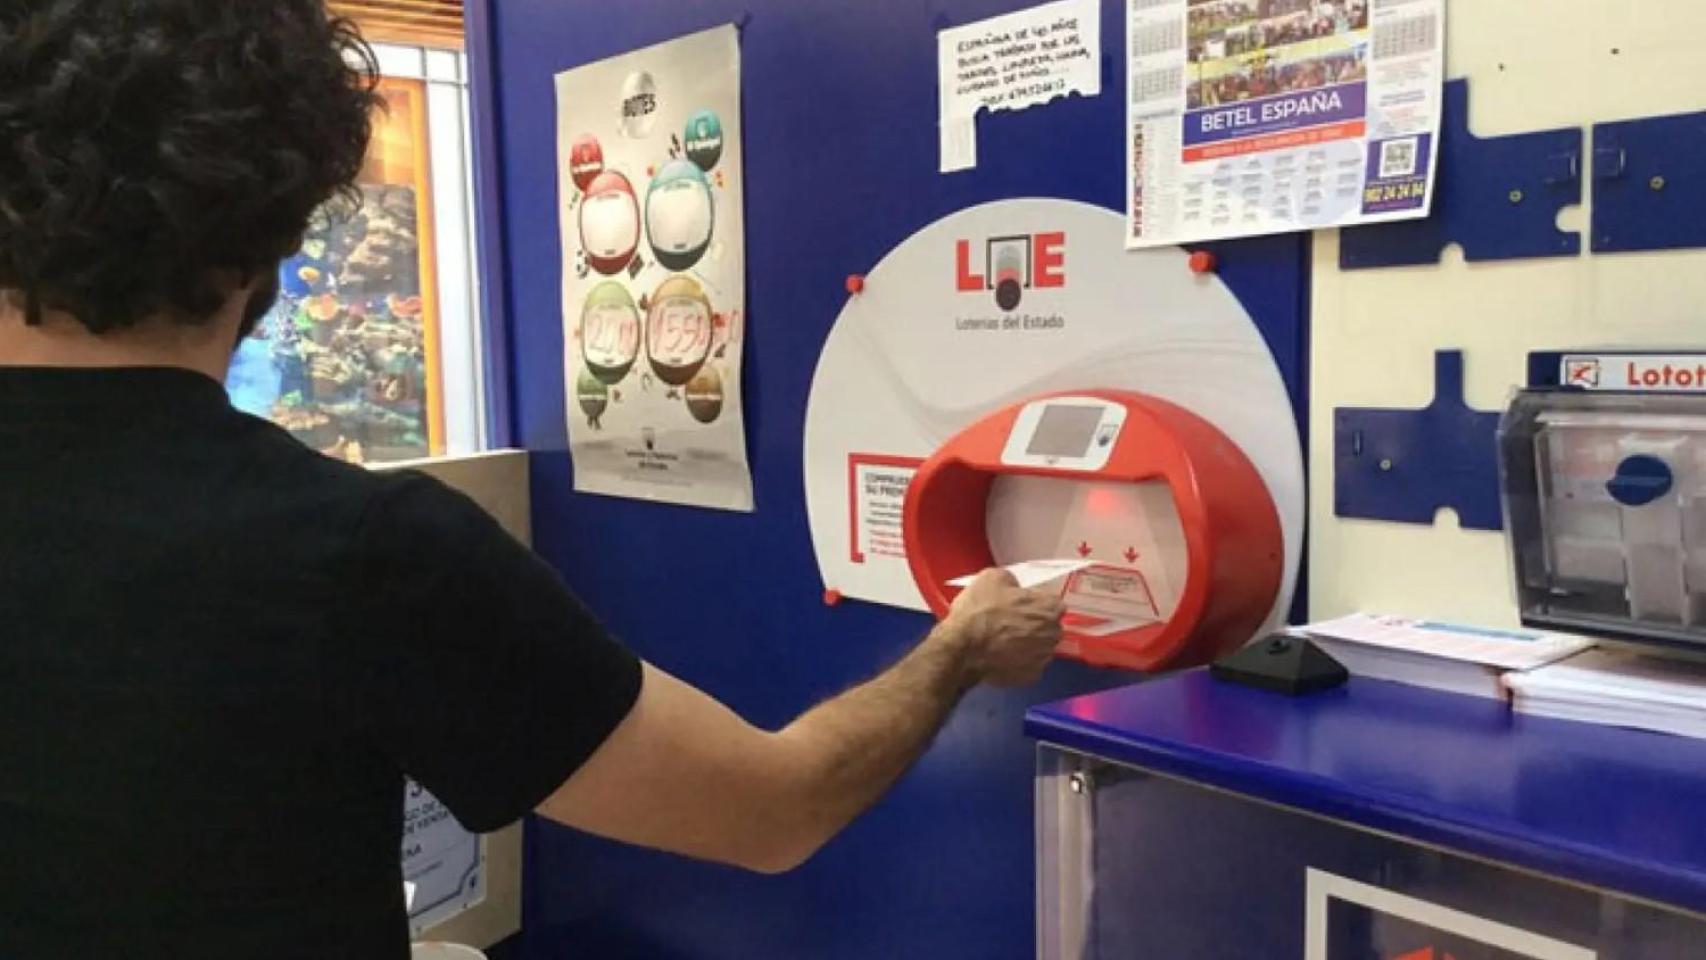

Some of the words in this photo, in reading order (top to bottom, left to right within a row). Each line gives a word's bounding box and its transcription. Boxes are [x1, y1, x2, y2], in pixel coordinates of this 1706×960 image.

[1200, 108, 1257, 133] BETEL
[1261, 89, 1343, 122] ESPAÑA
[1003, 315, 1019, 330] del
[1023, 314, 1064, 330] Estado
